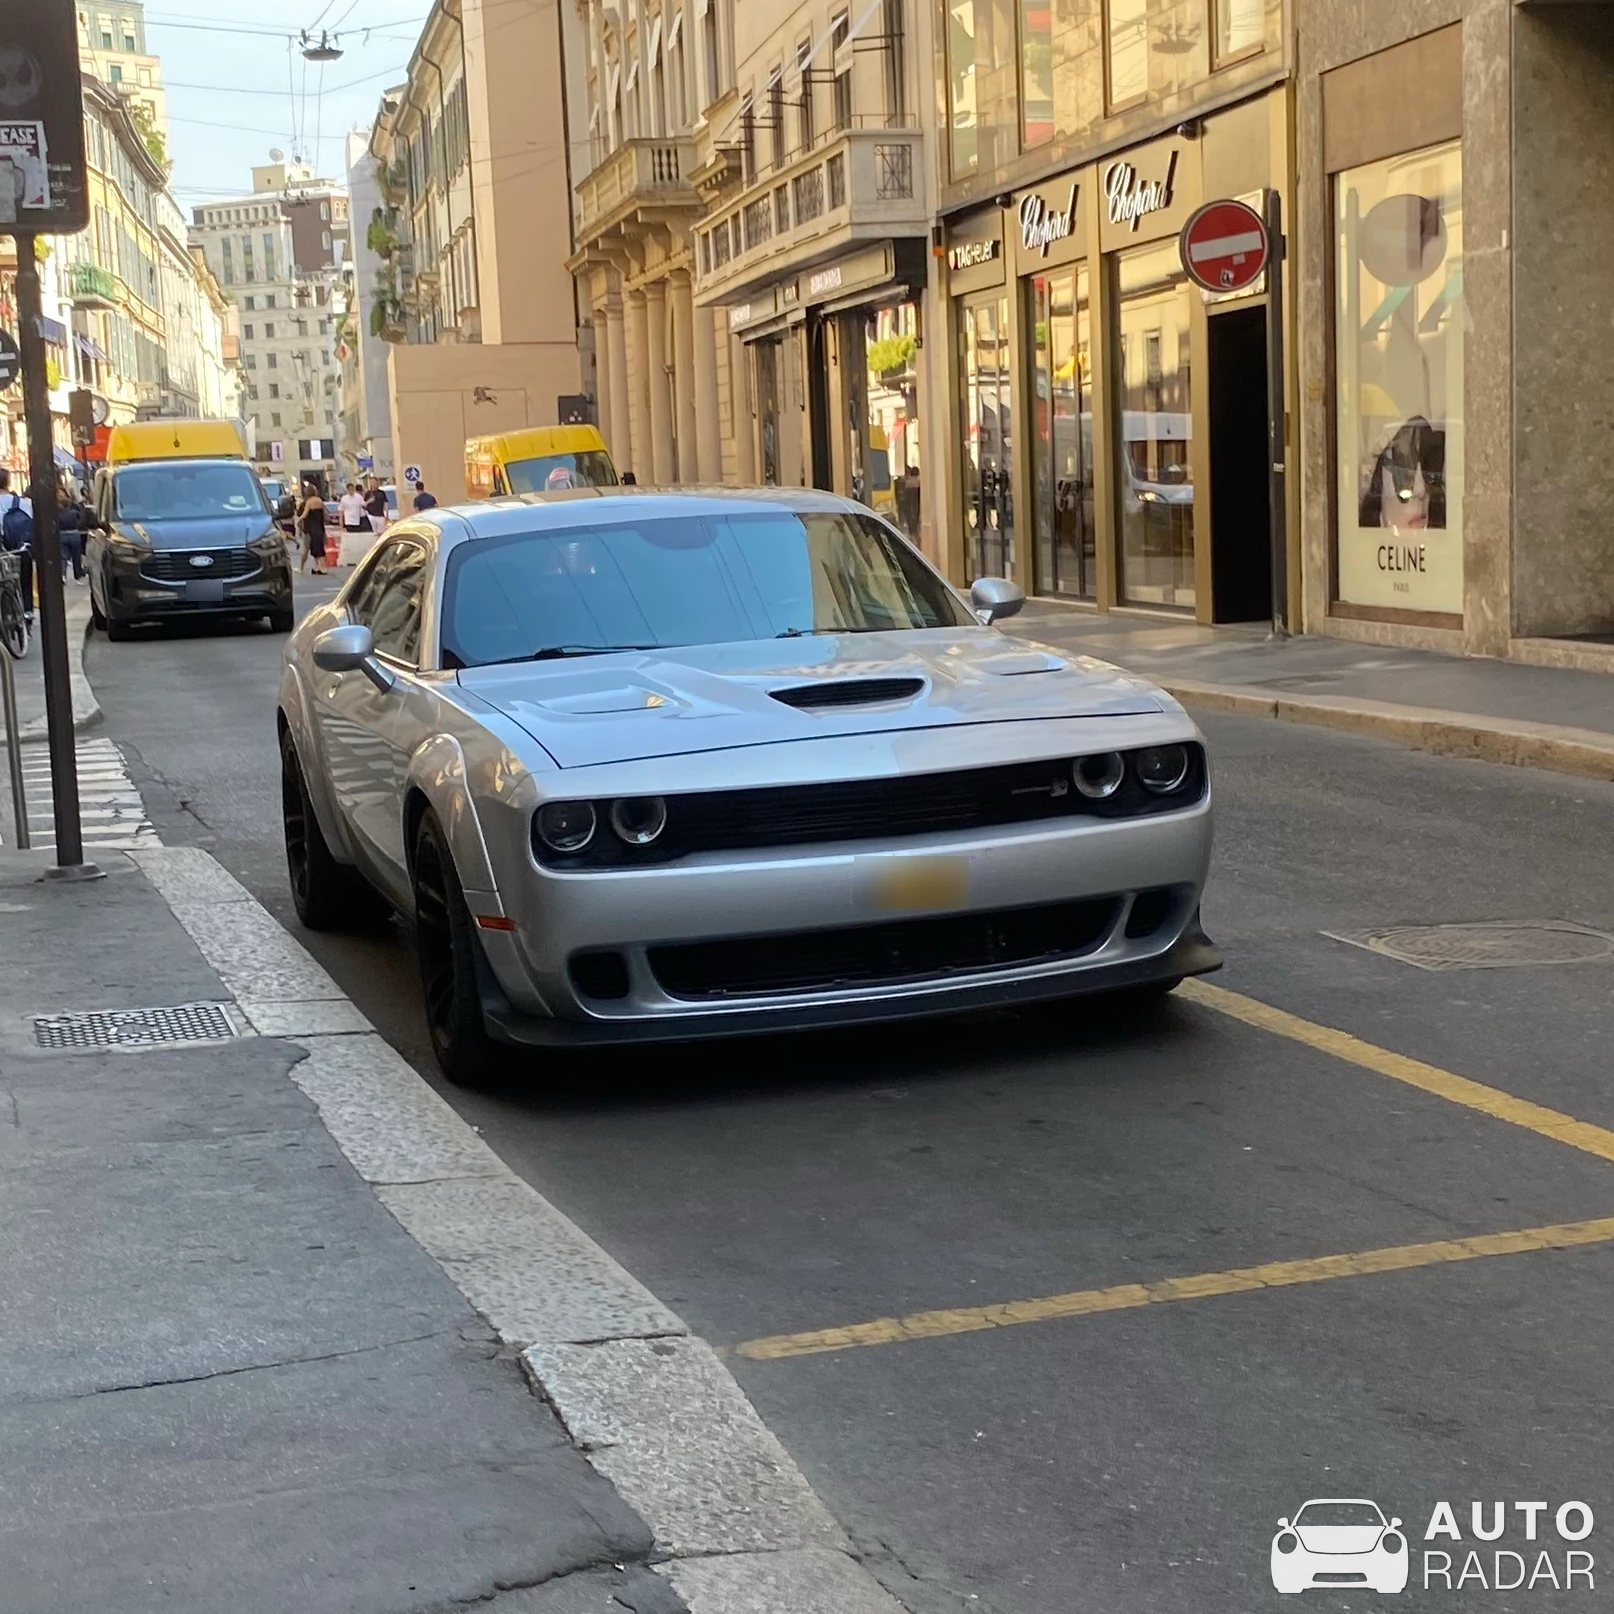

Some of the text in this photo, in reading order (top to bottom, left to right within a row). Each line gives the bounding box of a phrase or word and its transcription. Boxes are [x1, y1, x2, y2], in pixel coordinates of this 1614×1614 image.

[0, 127, 36, 144] EASE
[1104, 151, 1175, 232] Chopard
[1018, 184, 1076, 258] Chopard
[1377, 545, 1426, 573] CELINE
